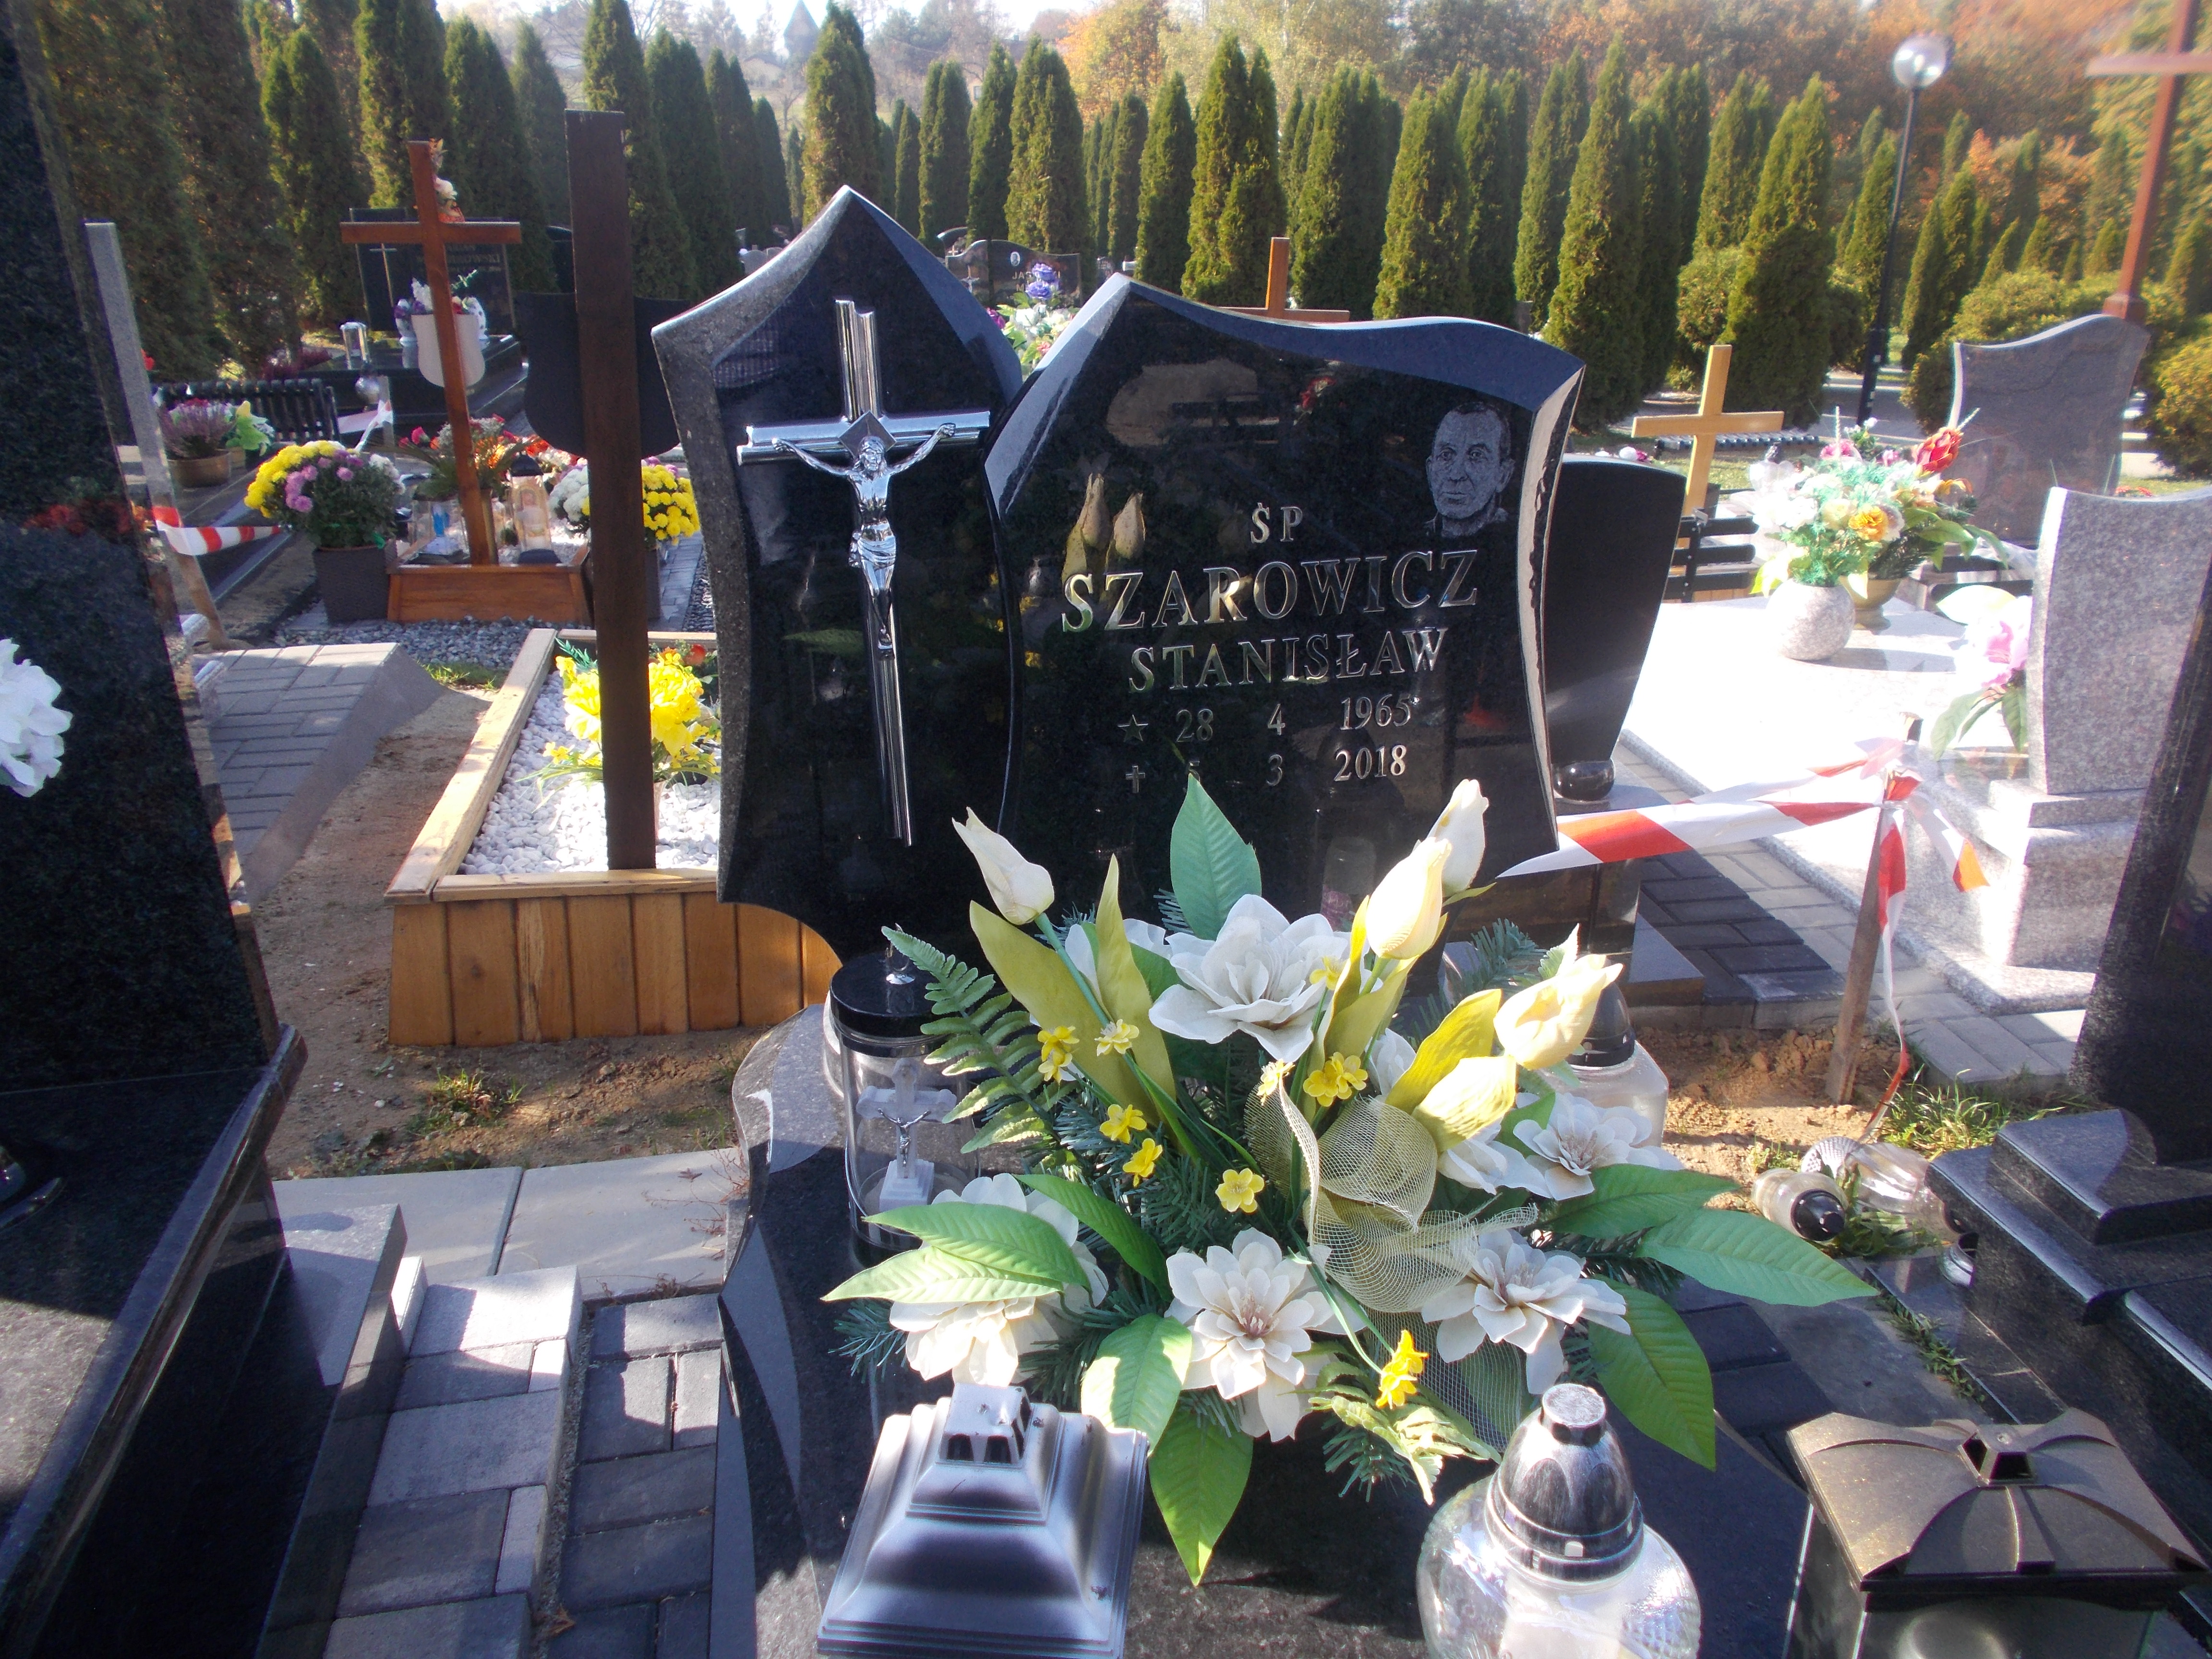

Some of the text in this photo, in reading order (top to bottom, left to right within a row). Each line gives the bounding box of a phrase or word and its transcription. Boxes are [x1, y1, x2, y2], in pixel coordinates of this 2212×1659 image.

[1250, 502, 1303, 544] Ś P
[1061, 550, 1478, 632] SZAROWICZ
[1129, 627, 1449, 693] STANISŁAW
[1176, 694, 1413, 743] 28 4 1965
[1266, 754, 1283, 786] 3
[1334, 745, 1408, 782] 2018
